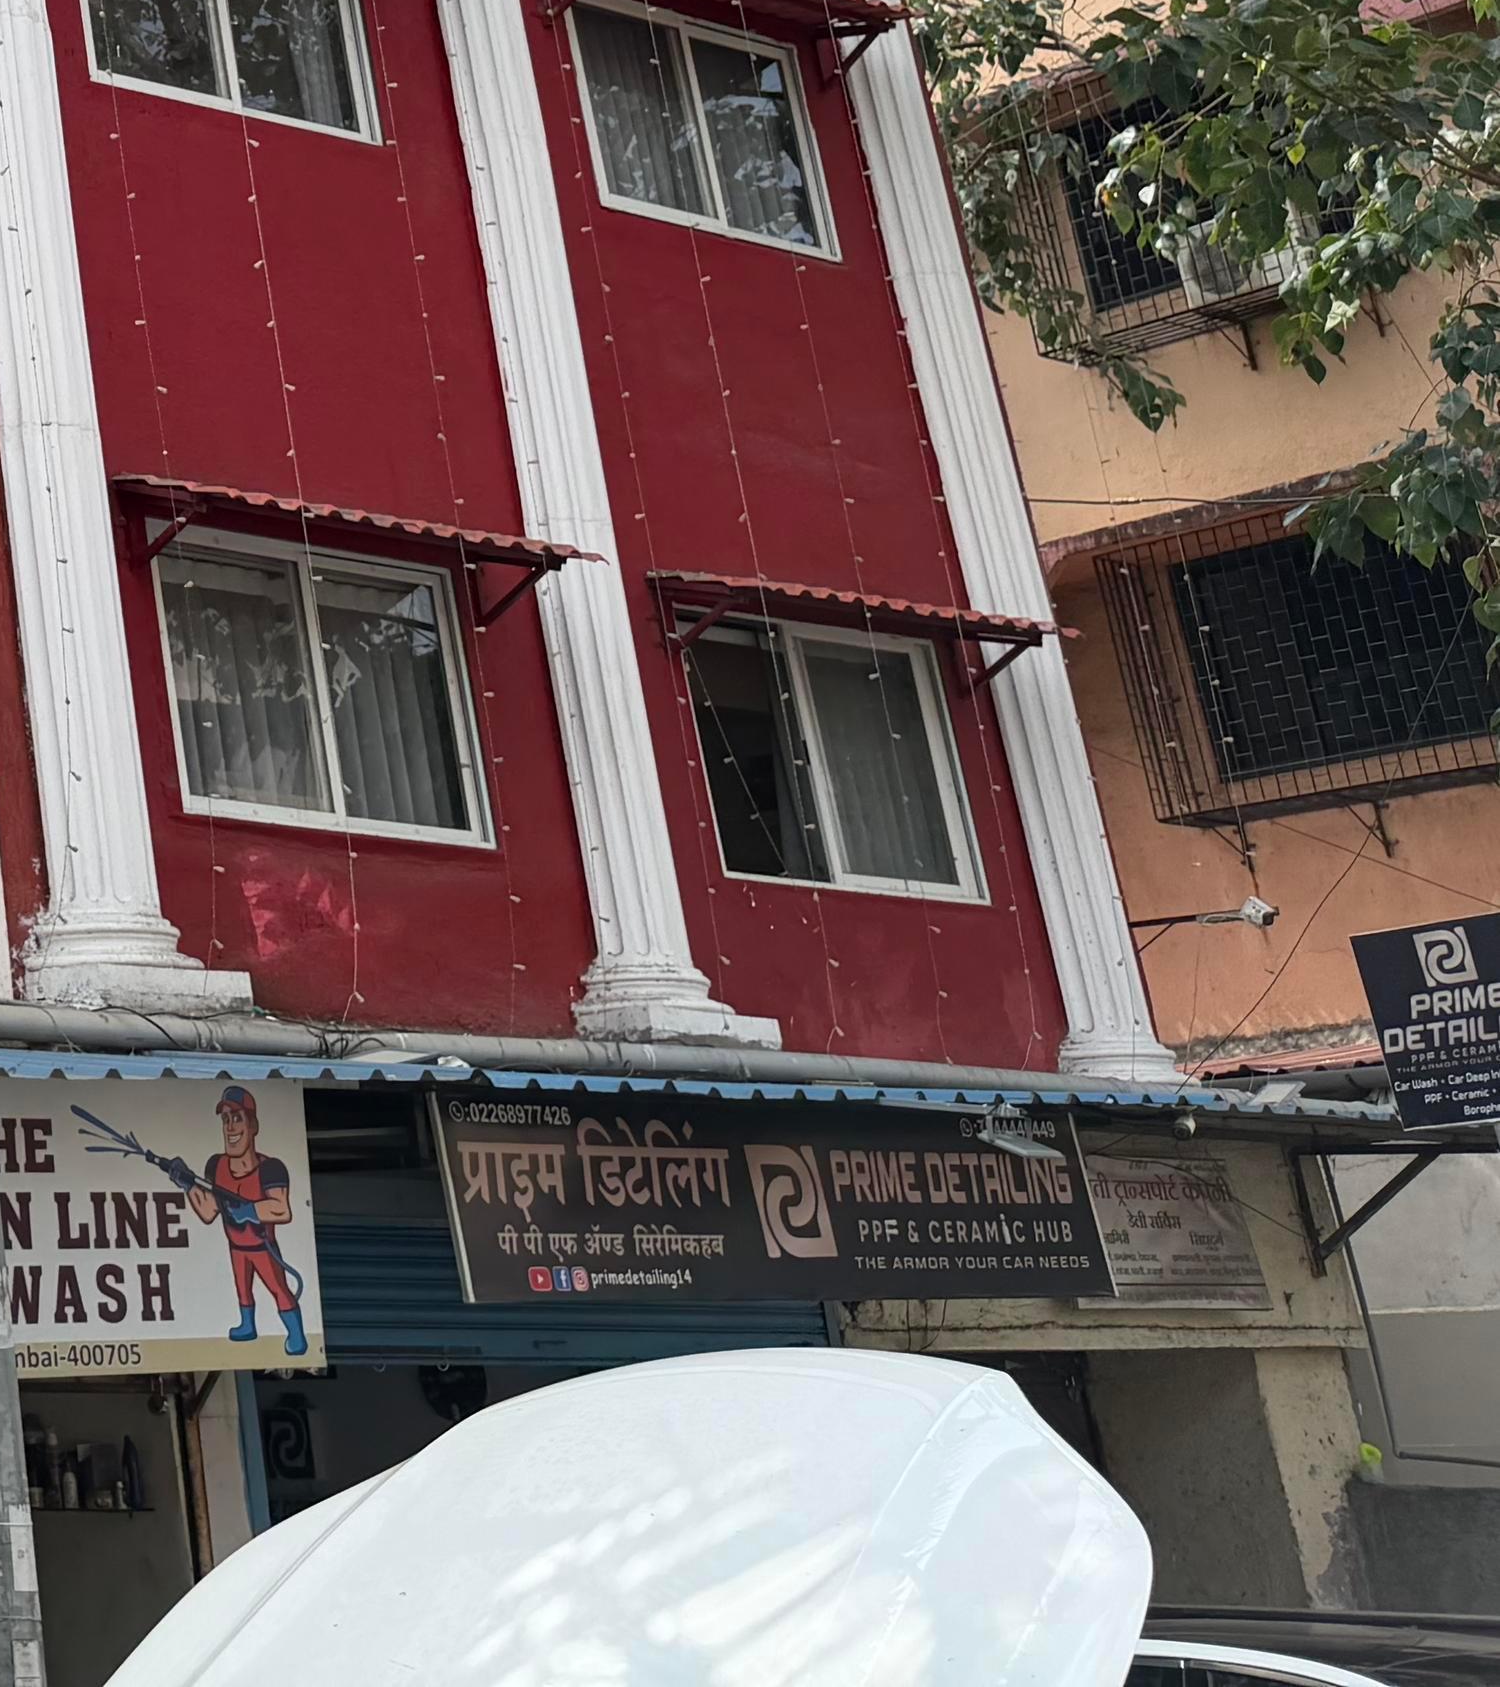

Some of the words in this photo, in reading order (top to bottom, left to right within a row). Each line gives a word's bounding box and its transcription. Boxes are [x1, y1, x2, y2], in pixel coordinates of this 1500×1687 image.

[1410, 982, 1500, 1020] PRIME
[1383, 1014, 1500, 1054] DETAIL
[1394, 1081, 1411, 1092] Car
[1412, 1078, 1438, 1089] Wash
[1448, 1074, 1464, 1085] Car
[1466, 1072, 1490, 1083] Deep
[1424, 1092, 1442, 1104] PPF
[1452, 1088, 1490, 1101] Ceramic
[457, 1140, 566, 1222] प्राइम
[577, 1117, 731, 1207] डिटेलिंग
[830, 1150, 922, 1203] PRIME
[924, 1152, 1074, 1204] DETAILING
[54, 1192, 189, 1249] LINE
[858, 1219, 899, 1242] PPF
[908, 1219, 920, 1243] &
[1034, 1220, 1073, 1243] HUB
[498, 1223, 518, 1255] पी
[524, 1223, 543, 1255] पी
[548, 1231, 578, 1262] एफ
[591, 1268, 692, 1289] primedetailing14
[855, 1256, 887, 1269] THE
[893, 1256, 950, 1269] ARMOR
[955, 1256, 998, 1269] YOUR
[1003, 1256, 1034, 1269] CAR
[1039, 1256, 1090, 1268] NEEDS
[8, 1263, 175, 1325] WASH
[15, 1344, 142, 1370] mbai-400705
